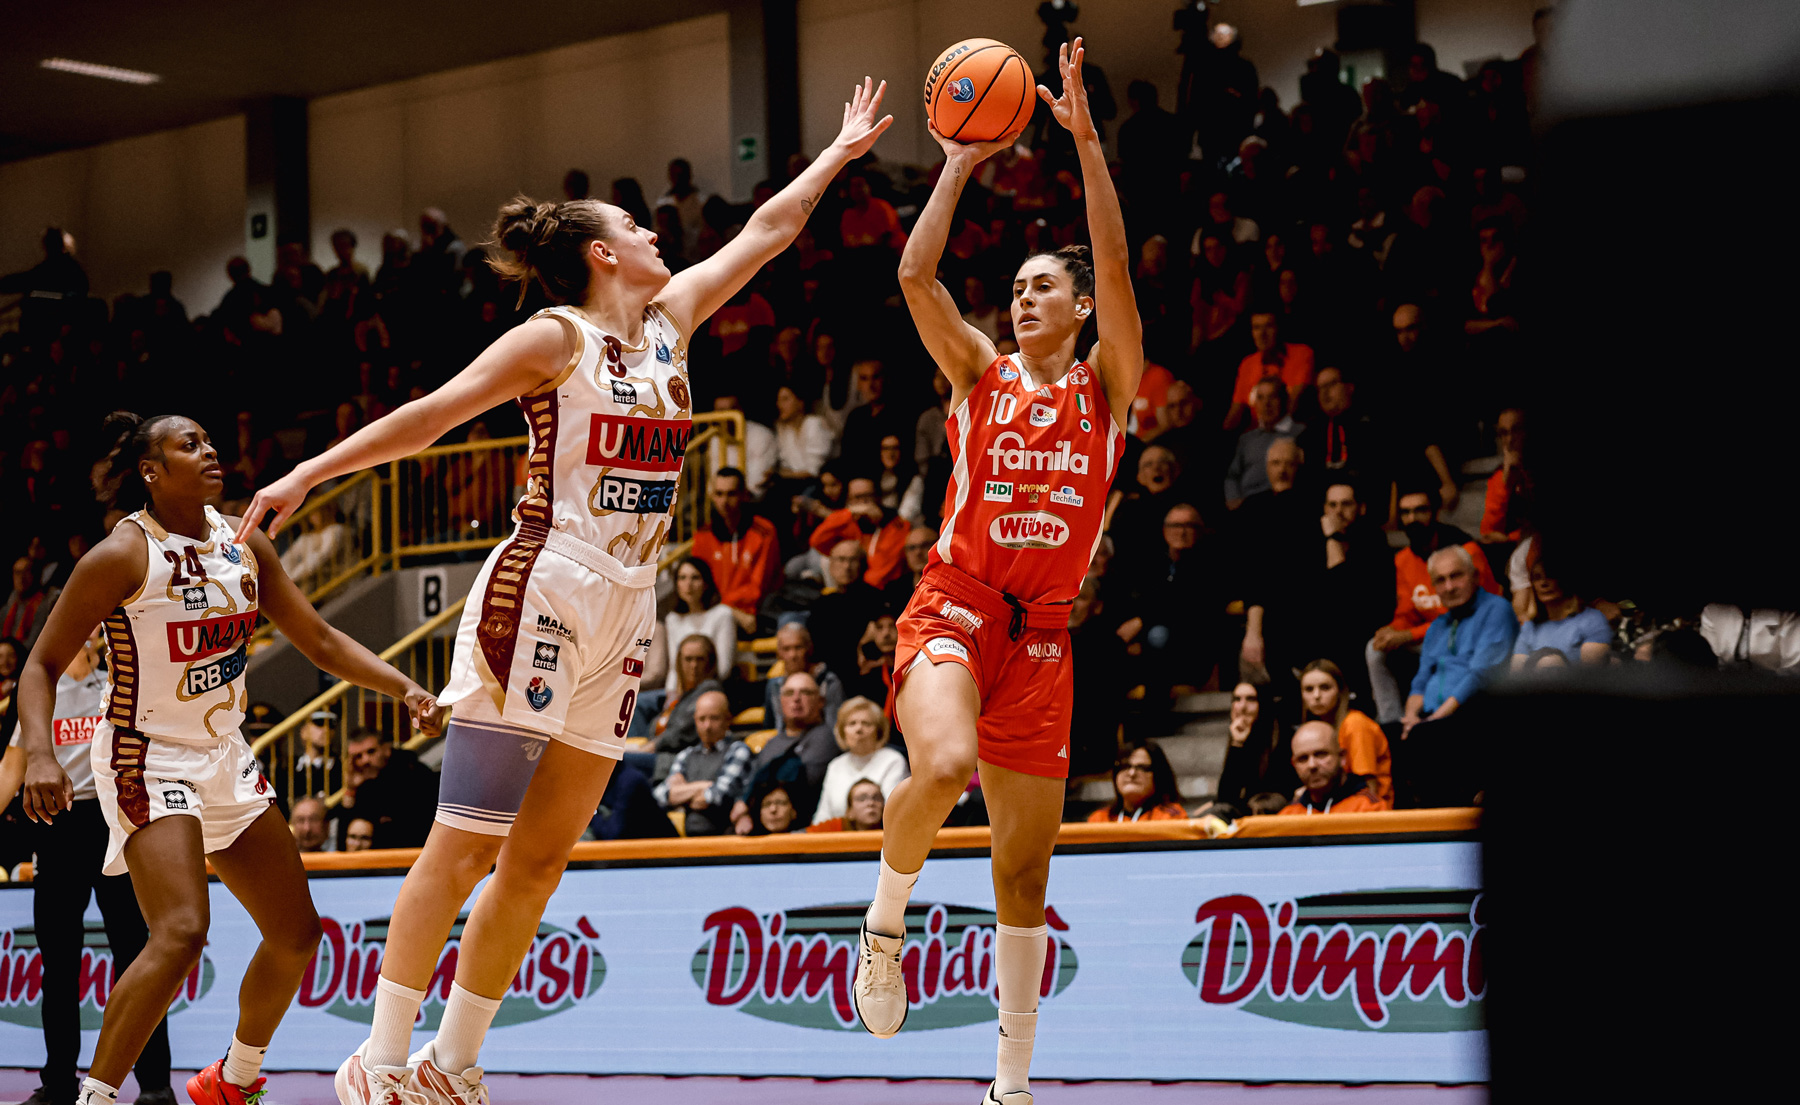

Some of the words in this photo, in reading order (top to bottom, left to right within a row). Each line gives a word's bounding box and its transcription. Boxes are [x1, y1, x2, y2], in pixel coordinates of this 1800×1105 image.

[603, 335, 627, 378] 9
[986, 390, 1018, 426] 10
[987, 431, 1089, 476] famila
[986, 483, 1013, 496] HDI
[1018, 483, 1050, 493] HYPNO
[1052, 493, 1081, 505] Techfind
[999, 517, 1064, 541] Wüber
[164, 545, 209, 586] 24
[424, 575, 441, 617] B
[532, 693, 547, 704] LBF
[614, 689, 635, 738] 9
[59, 728, 93, 742] GROU
